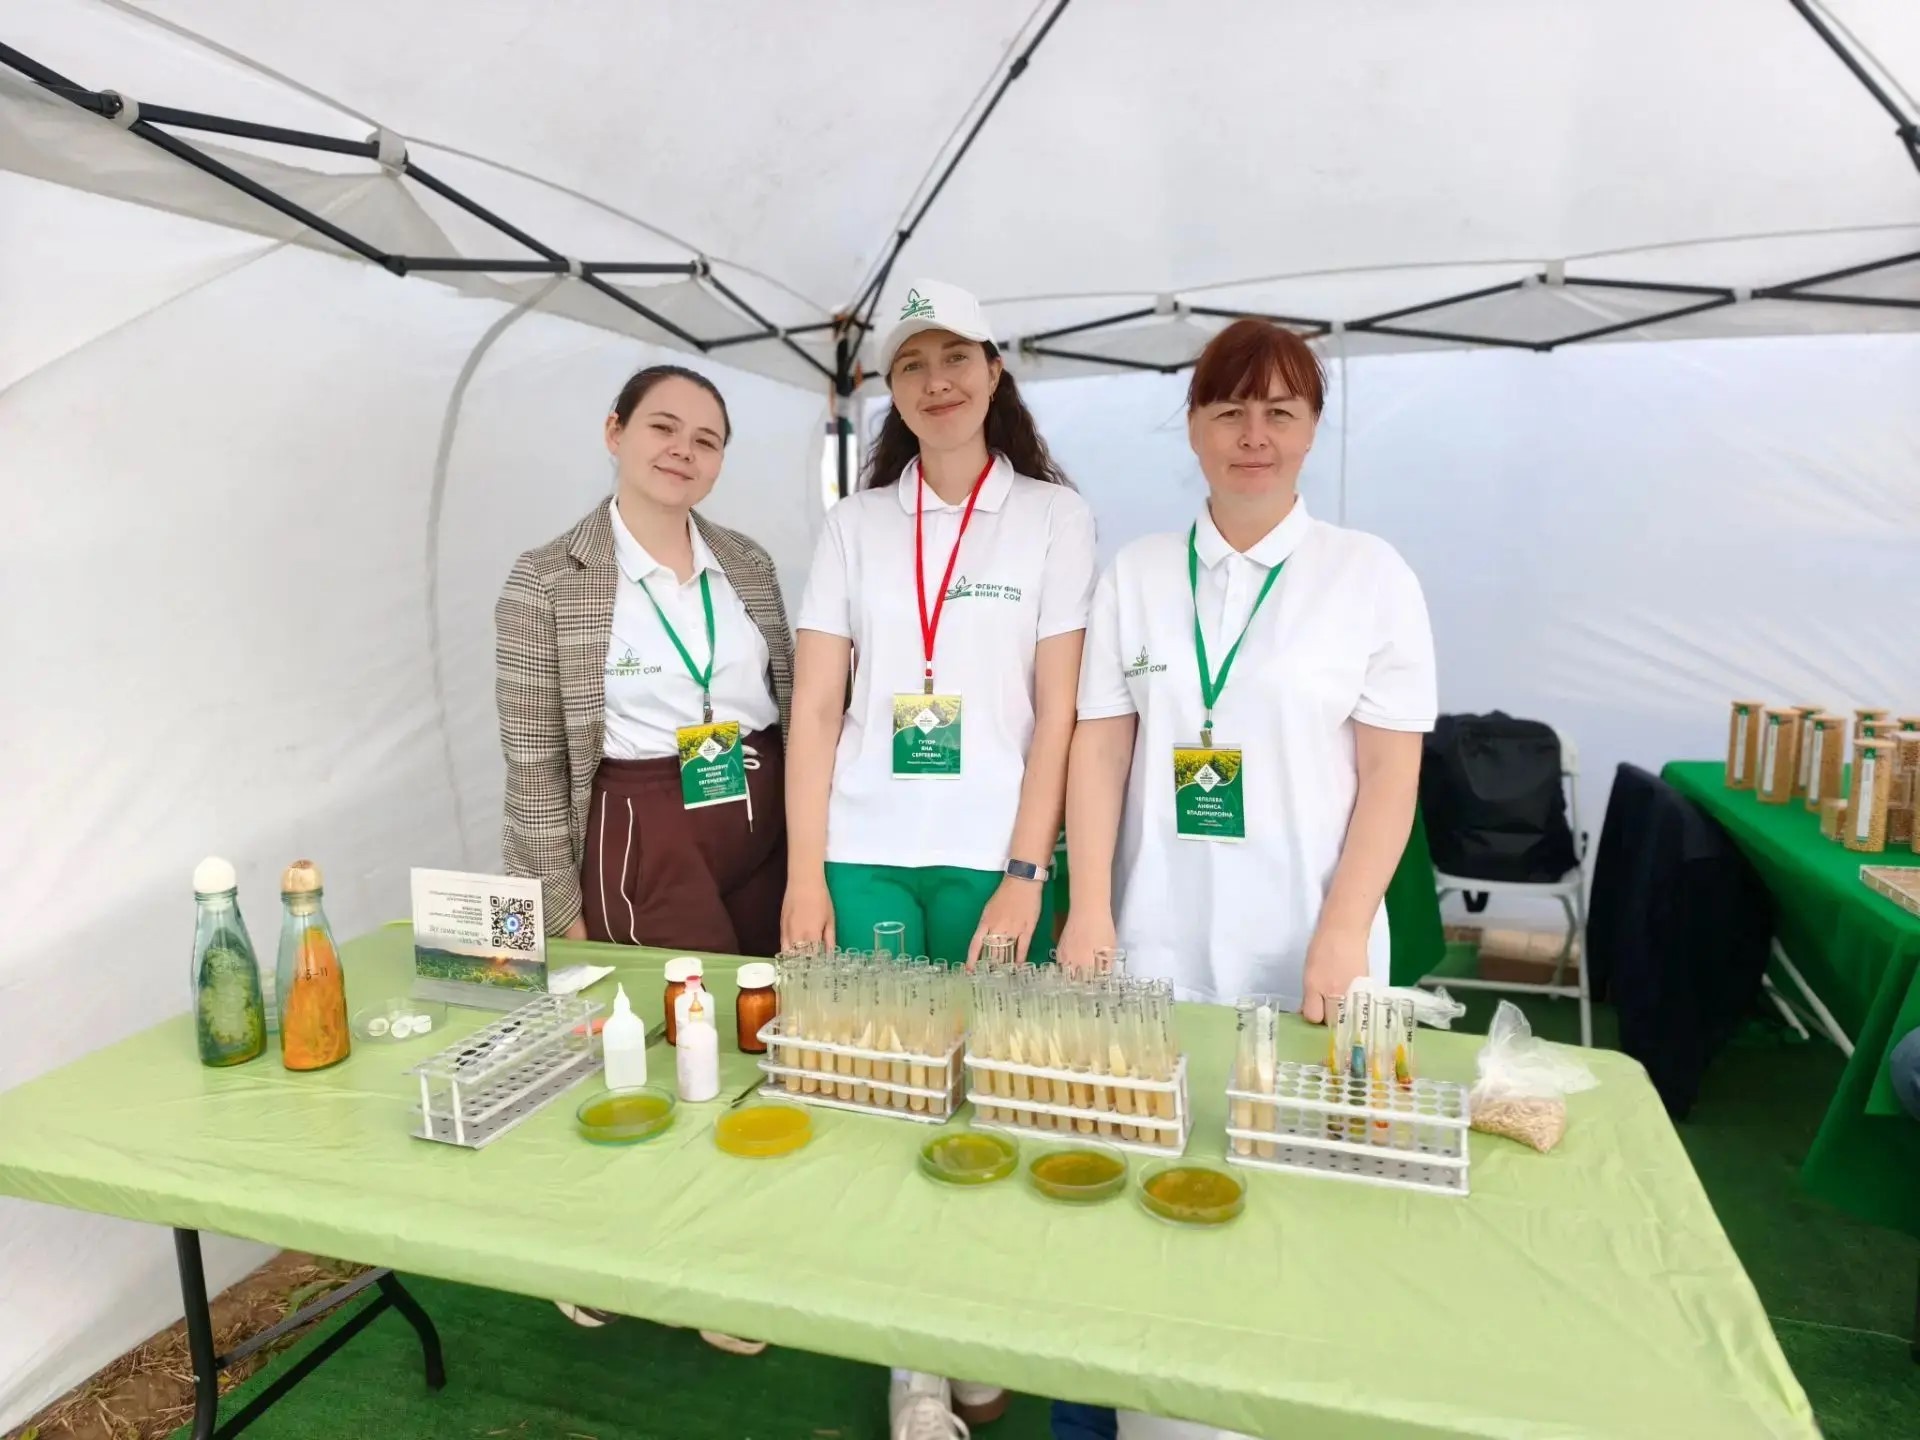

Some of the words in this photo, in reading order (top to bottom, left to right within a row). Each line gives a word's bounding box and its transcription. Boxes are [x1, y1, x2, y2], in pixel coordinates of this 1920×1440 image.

[975, 583, 1002, 592] ФГБНУ
[1004, 586, 1022, 596] ФНЦ
[1003, 593, 1021, 602] СОИ
[603, 668, 641, 677] НСТИТУТ
[644, 666, 662, 675] СОИ
[1150, 664, 1167, 673] СОИ
[1186, 810, 1234, 818] ВЛАДИМИРОВНА
